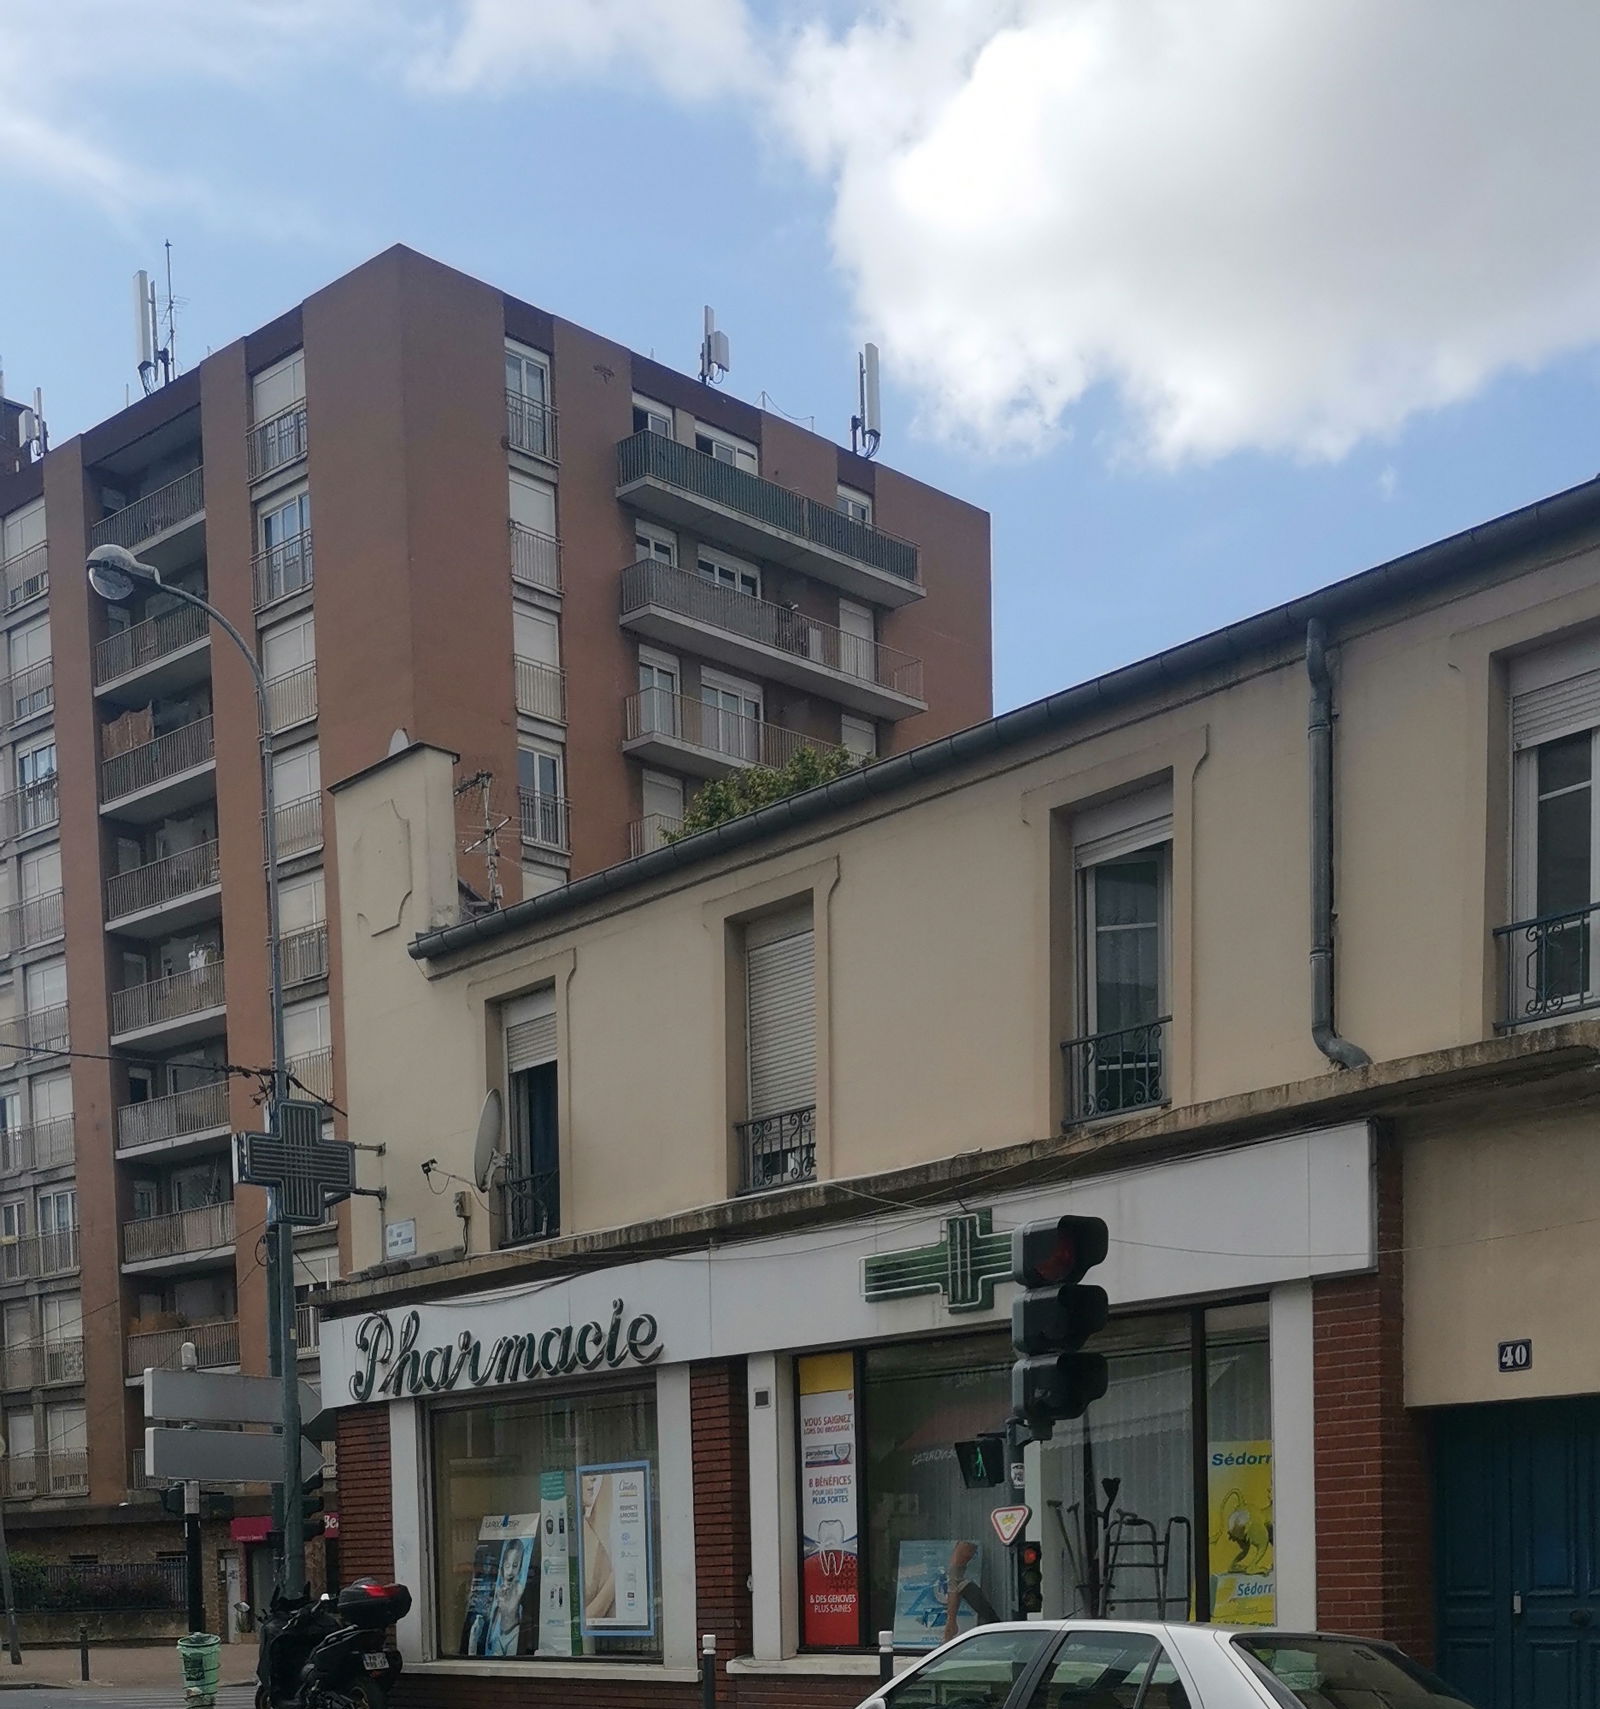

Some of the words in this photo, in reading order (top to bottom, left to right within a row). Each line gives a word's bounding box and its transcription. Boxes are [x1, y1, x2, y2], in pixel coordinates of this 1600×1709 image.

[350, 1298, 664, 1401] Pharmacie
[1501, 1344, 1527, 1367] 40
[803, 1416, 822, 1427] VOUS
[823, 1414, 853, 1426] SAIGNEZ
[816, 1425, 824, 1434] DU
[808, 1478, 814, 1488] 8
[815, 1475, 852, 1488] BÉNÉFICES
[812, 1496, 827, 1505] PLUS
[827, 1495, 849, 1504] FORTES
[810, 1594, 815, 1603] &
[815, 1594, 827, 1603] DES
[828, 1594, 857, 1603] GENCIVES
[814, 1605, 829, 1613] PLUS
[830, 1604, 852, 1613] SAINES
